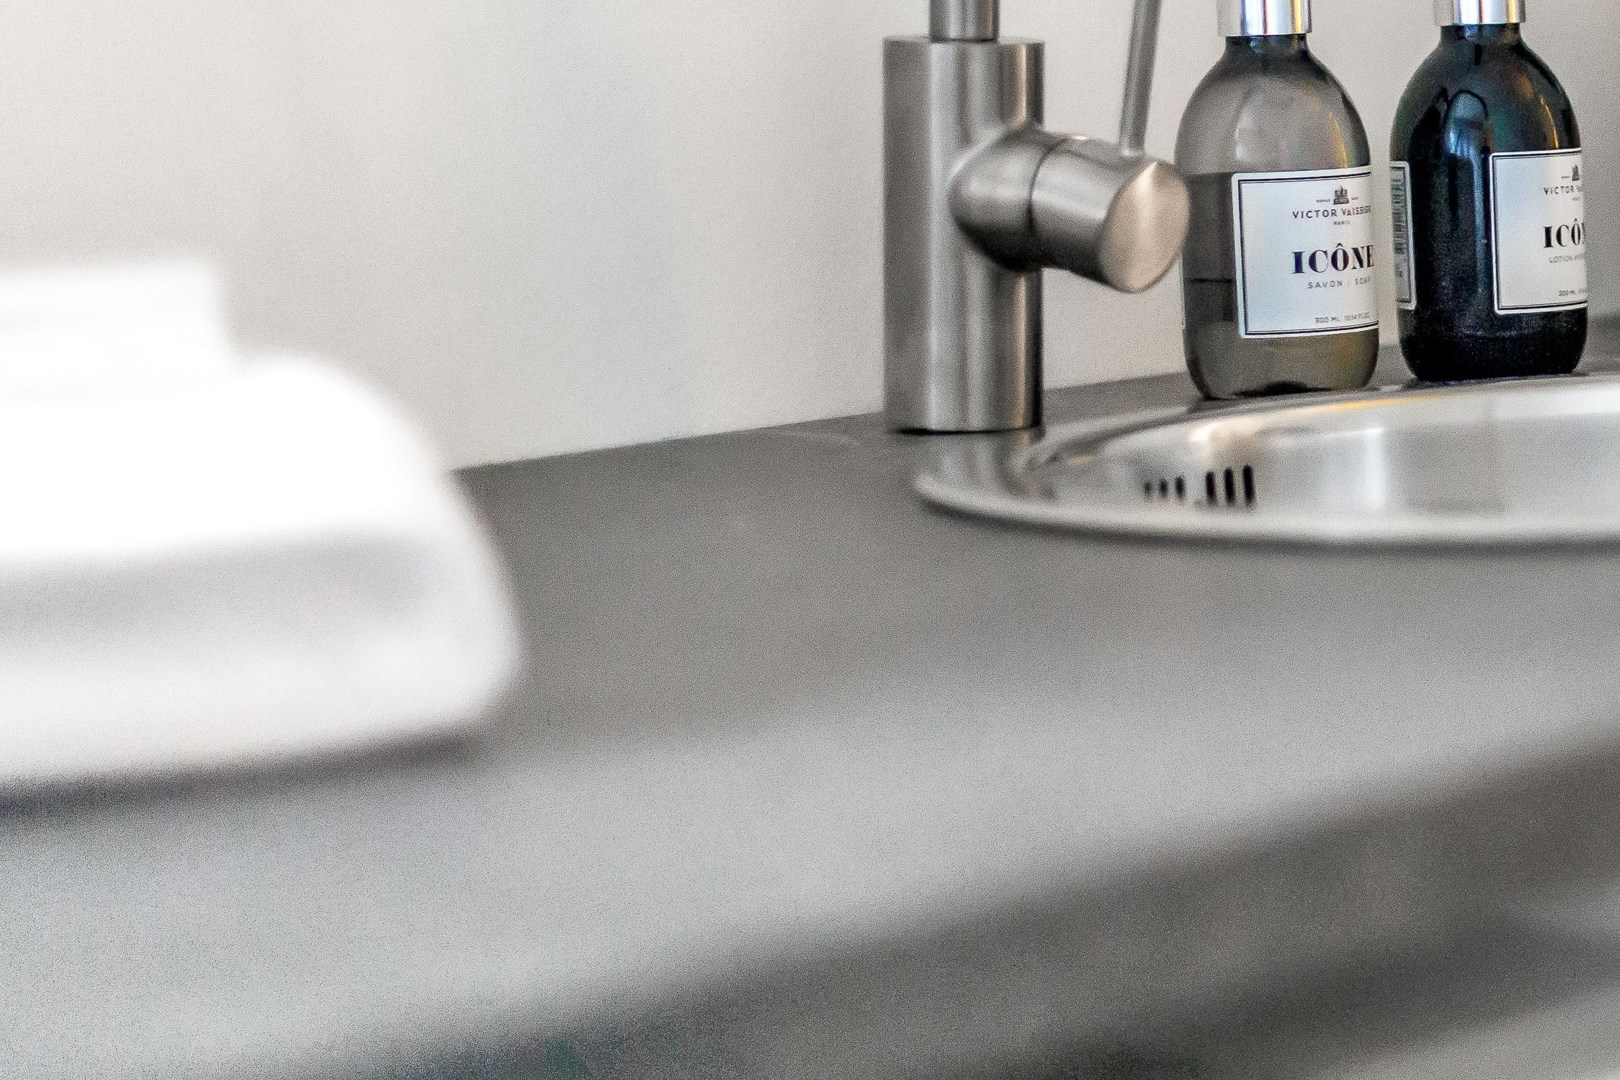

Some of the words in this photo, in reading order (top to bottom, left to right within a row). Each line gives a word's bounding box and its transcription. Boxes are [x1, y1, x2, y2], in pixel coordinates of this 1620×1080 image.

[1543, 184, 1575, 196] VICTOR
[1292, 208, 1338, 220] VICTOR
[1291, 242, 1375, 275] ICÔNE
[1307, 280, 1343, 289] SAVON
